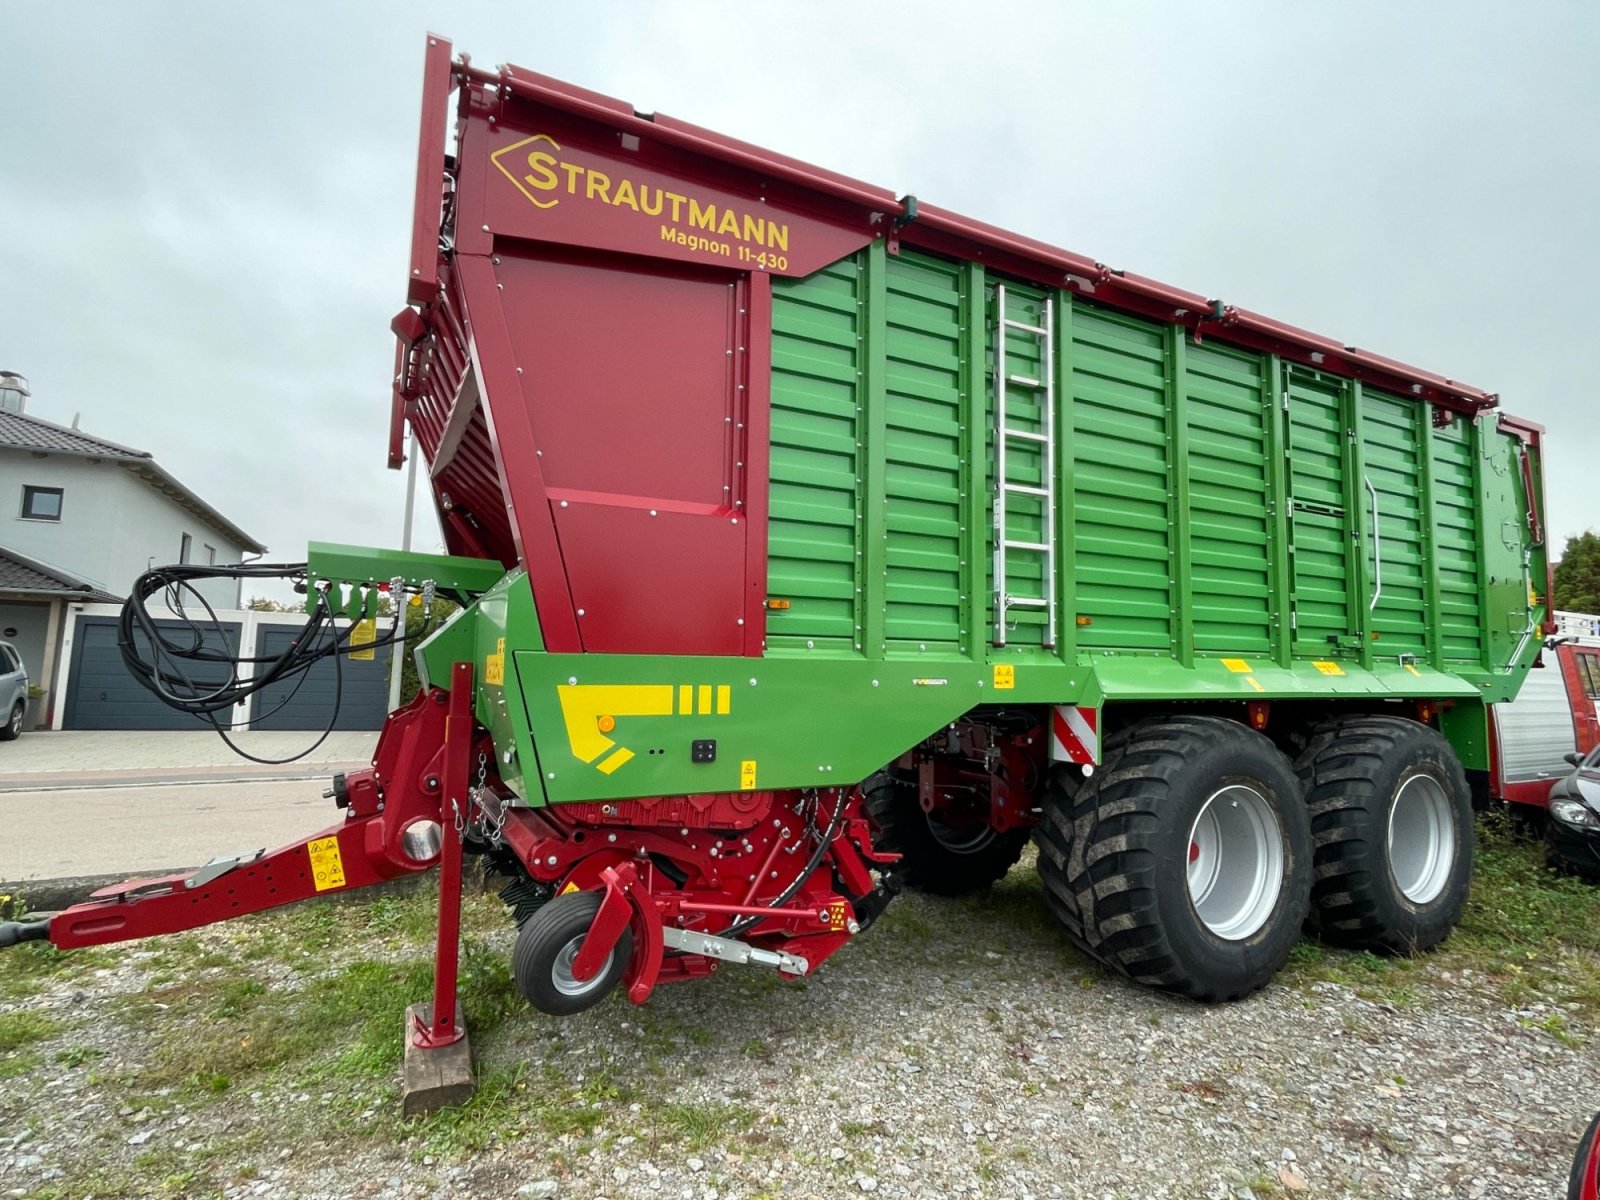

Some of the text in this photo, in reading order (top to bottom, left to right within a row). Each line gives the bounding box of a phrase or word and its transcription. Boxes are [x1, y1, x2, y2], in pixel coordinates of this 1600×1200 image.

[525, 152, 788, 251] STRAUTMANN
[661, 226, 788, 271] Magnon 11-430
